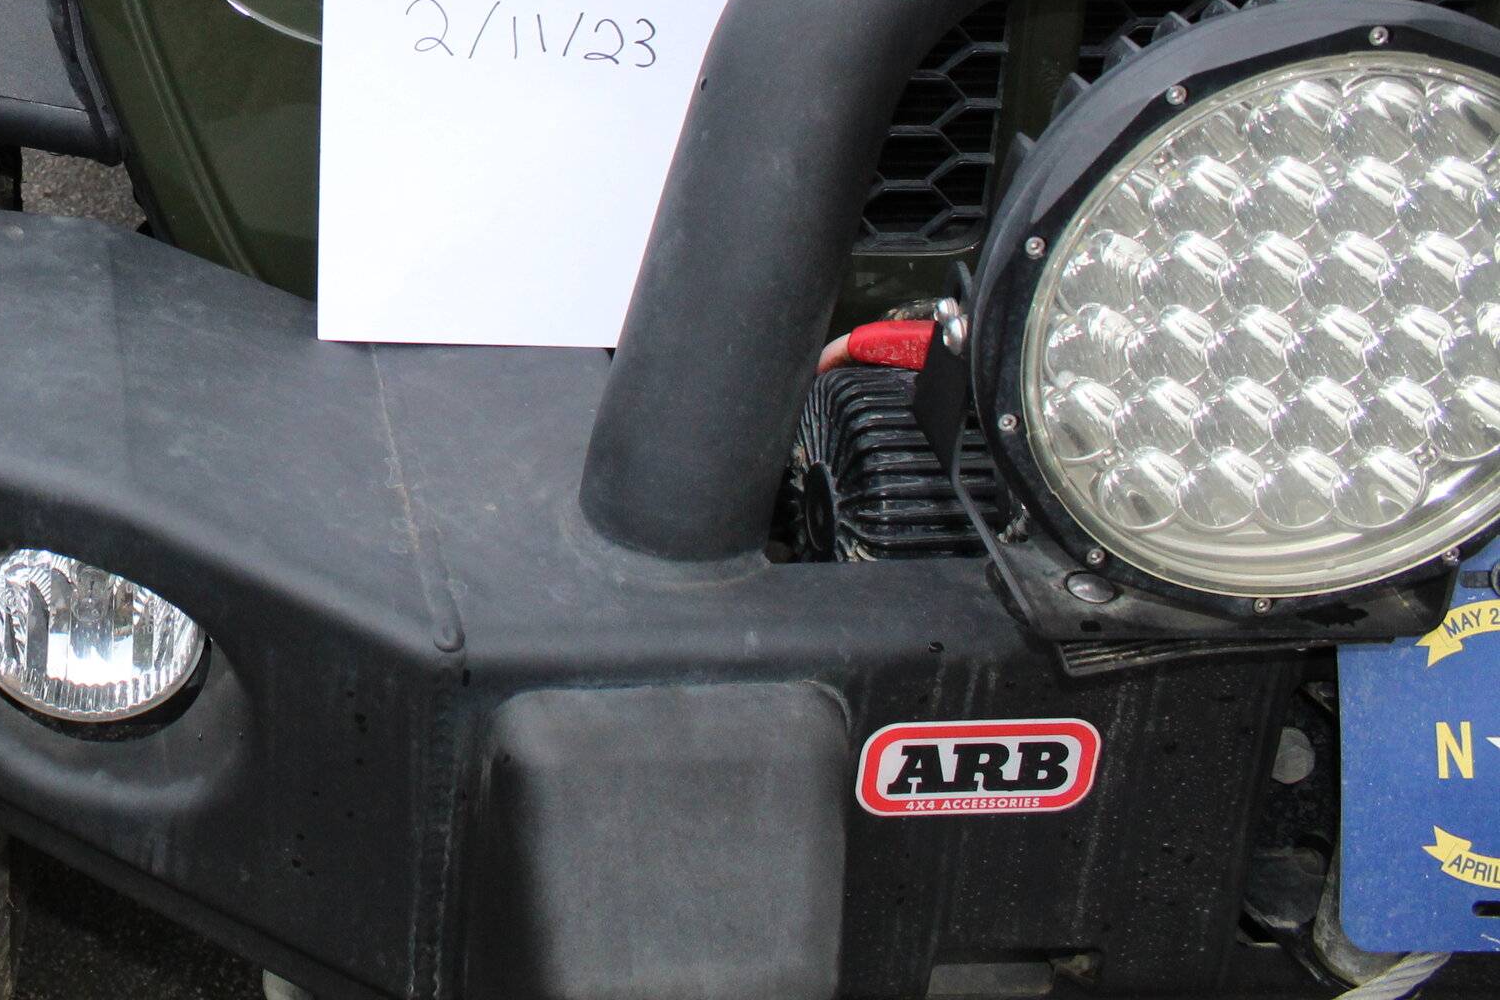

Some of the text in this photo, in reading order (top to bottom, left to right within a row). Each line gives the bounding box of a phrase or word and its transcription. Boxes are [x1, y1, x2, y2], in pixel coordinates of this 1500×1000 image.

[1443, 608, 1482, 638] MAY
[1435, 721, 1474, 779] N
[886, 741, 1069, 794] ARB
[905, 798, 1040, 811] 4X4 ACCESSORIES
[1448, 854, 1500, 883] APRIL
